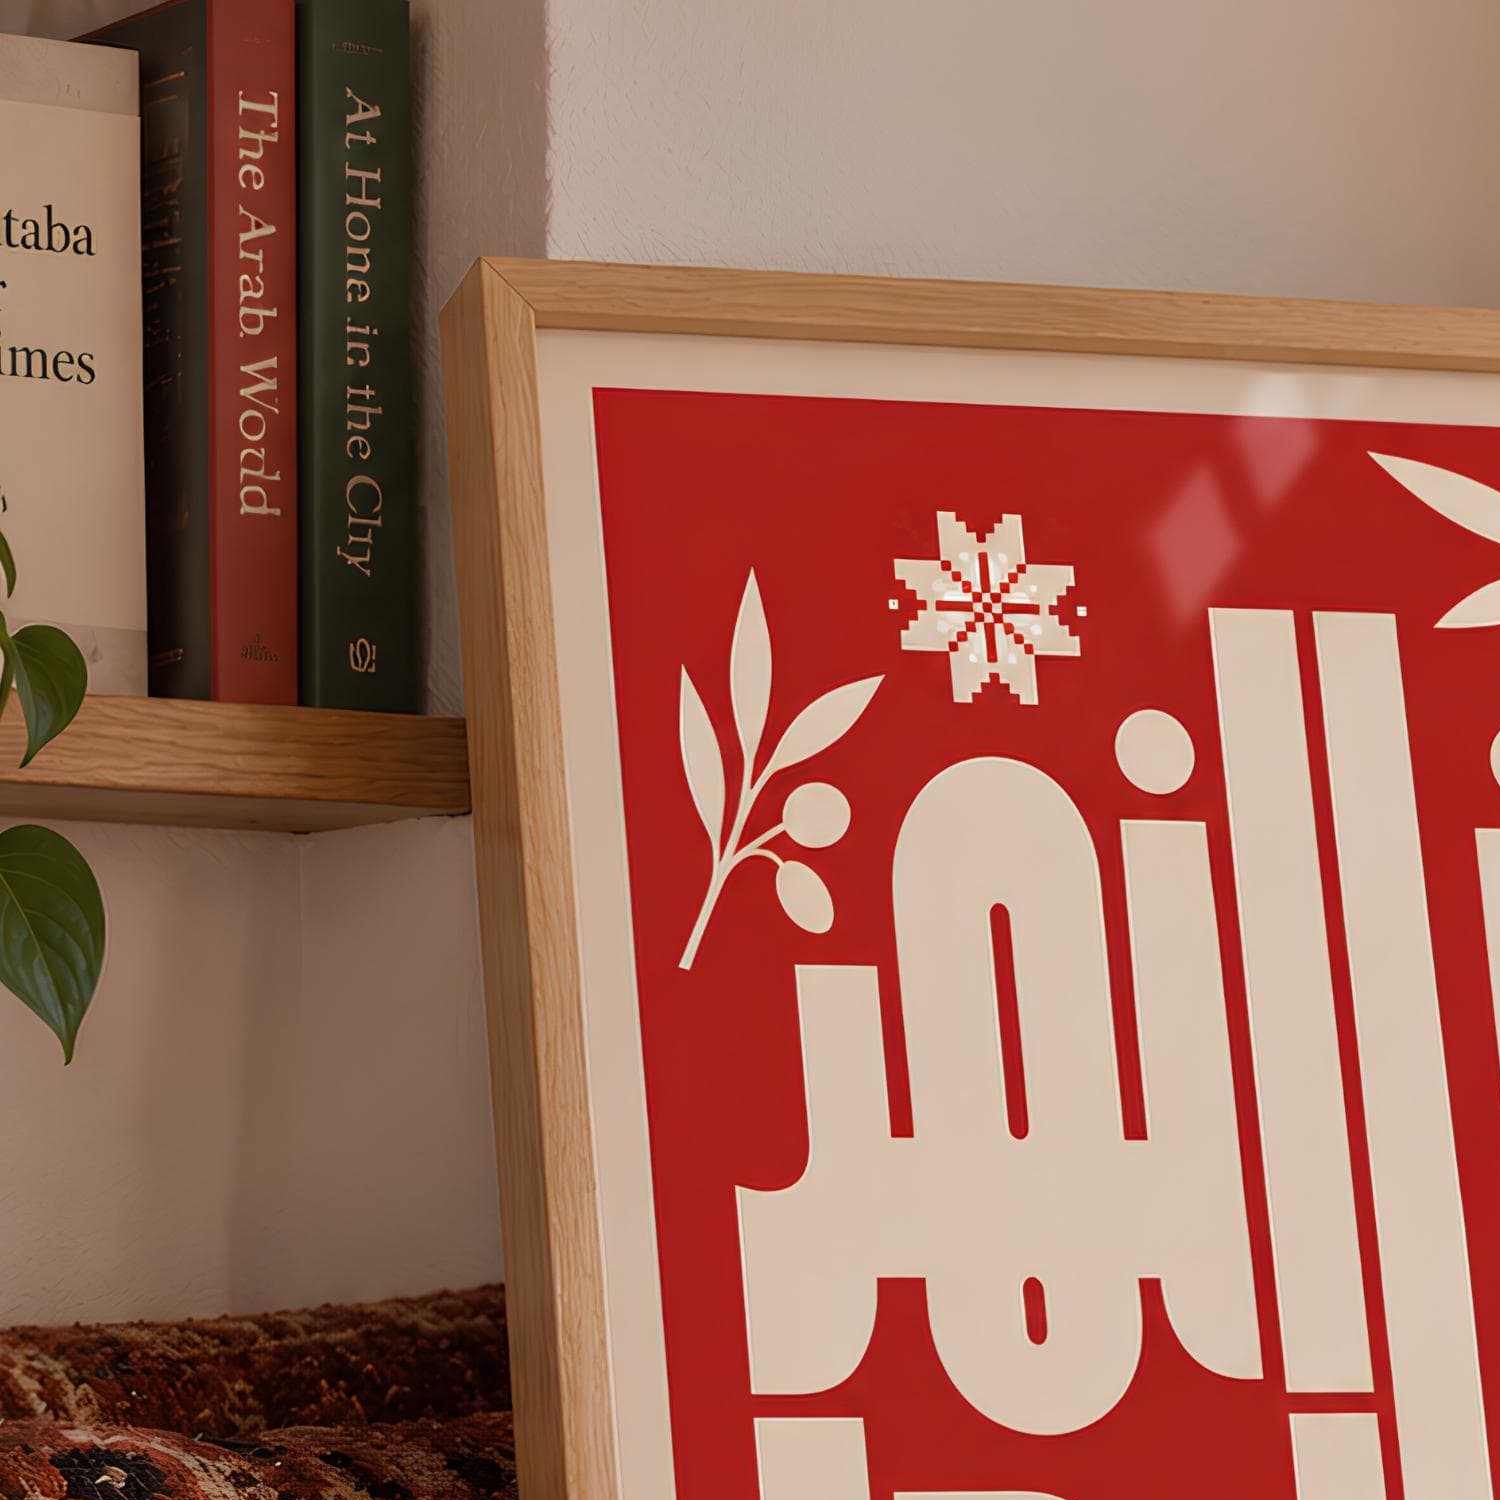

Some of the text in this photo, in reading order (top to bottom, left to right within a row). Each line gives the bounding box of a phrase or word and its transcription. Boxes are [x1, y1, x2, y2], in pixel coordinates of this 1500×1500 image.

[238, 90, 278, 190] The
[345, 87, 382, 150] At
[346, 384, 383, 460] the
